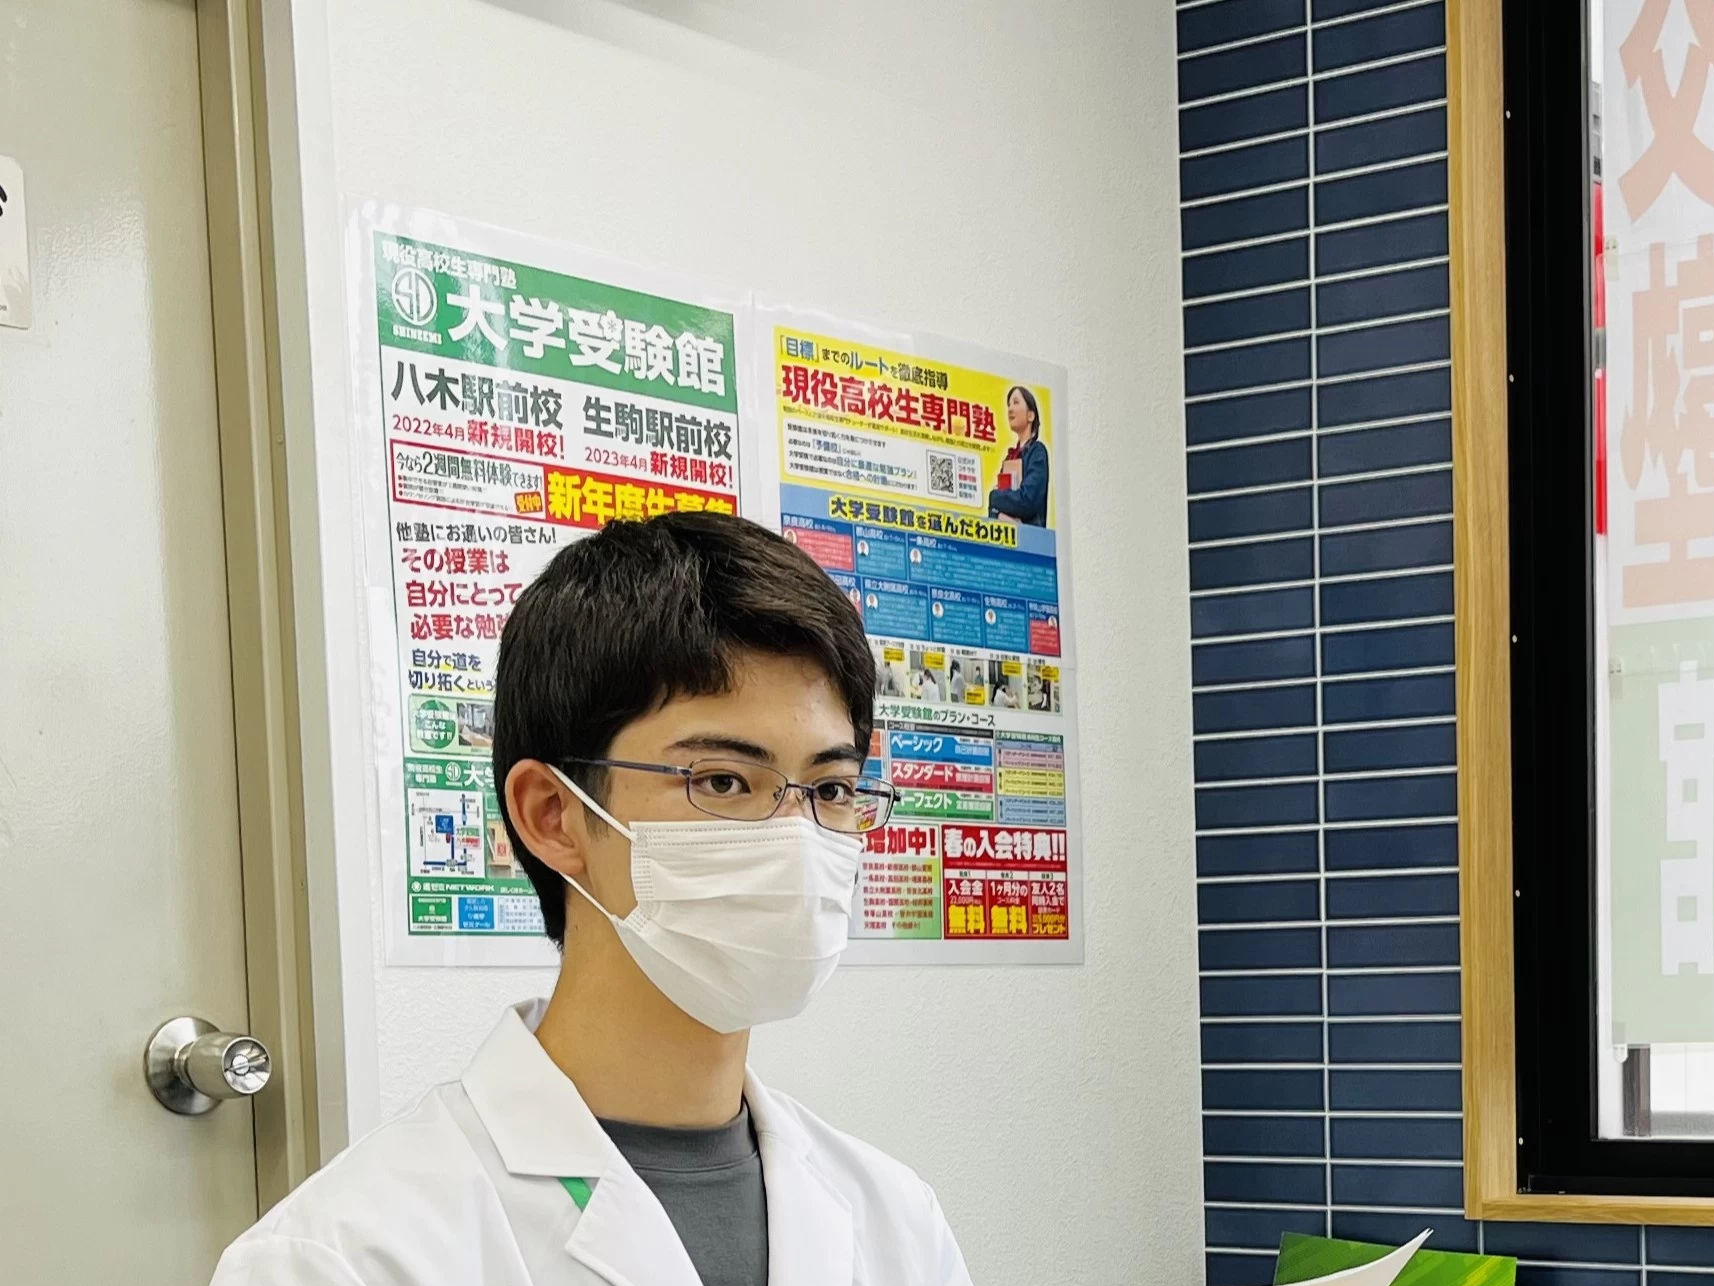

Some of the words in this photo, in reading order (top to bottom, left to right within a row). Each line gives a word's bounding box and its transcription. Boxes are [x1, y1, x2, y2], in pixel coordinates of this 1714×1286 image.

[381, 240, 517, 290] 現役高校生専門塾
[446, 283, 726, 397] 大学受験館
[391, 361, 564, 431] 八木駅前校
[583, 395, 733, 462] 生駒駅前校
[781, 364, 997, 443] 現役高校生専門塾
[396, 521, 557, 544] 他塾にお通いの皆さん!
[401, 548, 510, 575] その授業は
[412, 649, 481, 672] 自分で道を
[891, 734, 943, 754] ベーシック
[892, 762, 954, 783] スタンダード
[944, 828, 1066, 861] 春の入会特典!!
